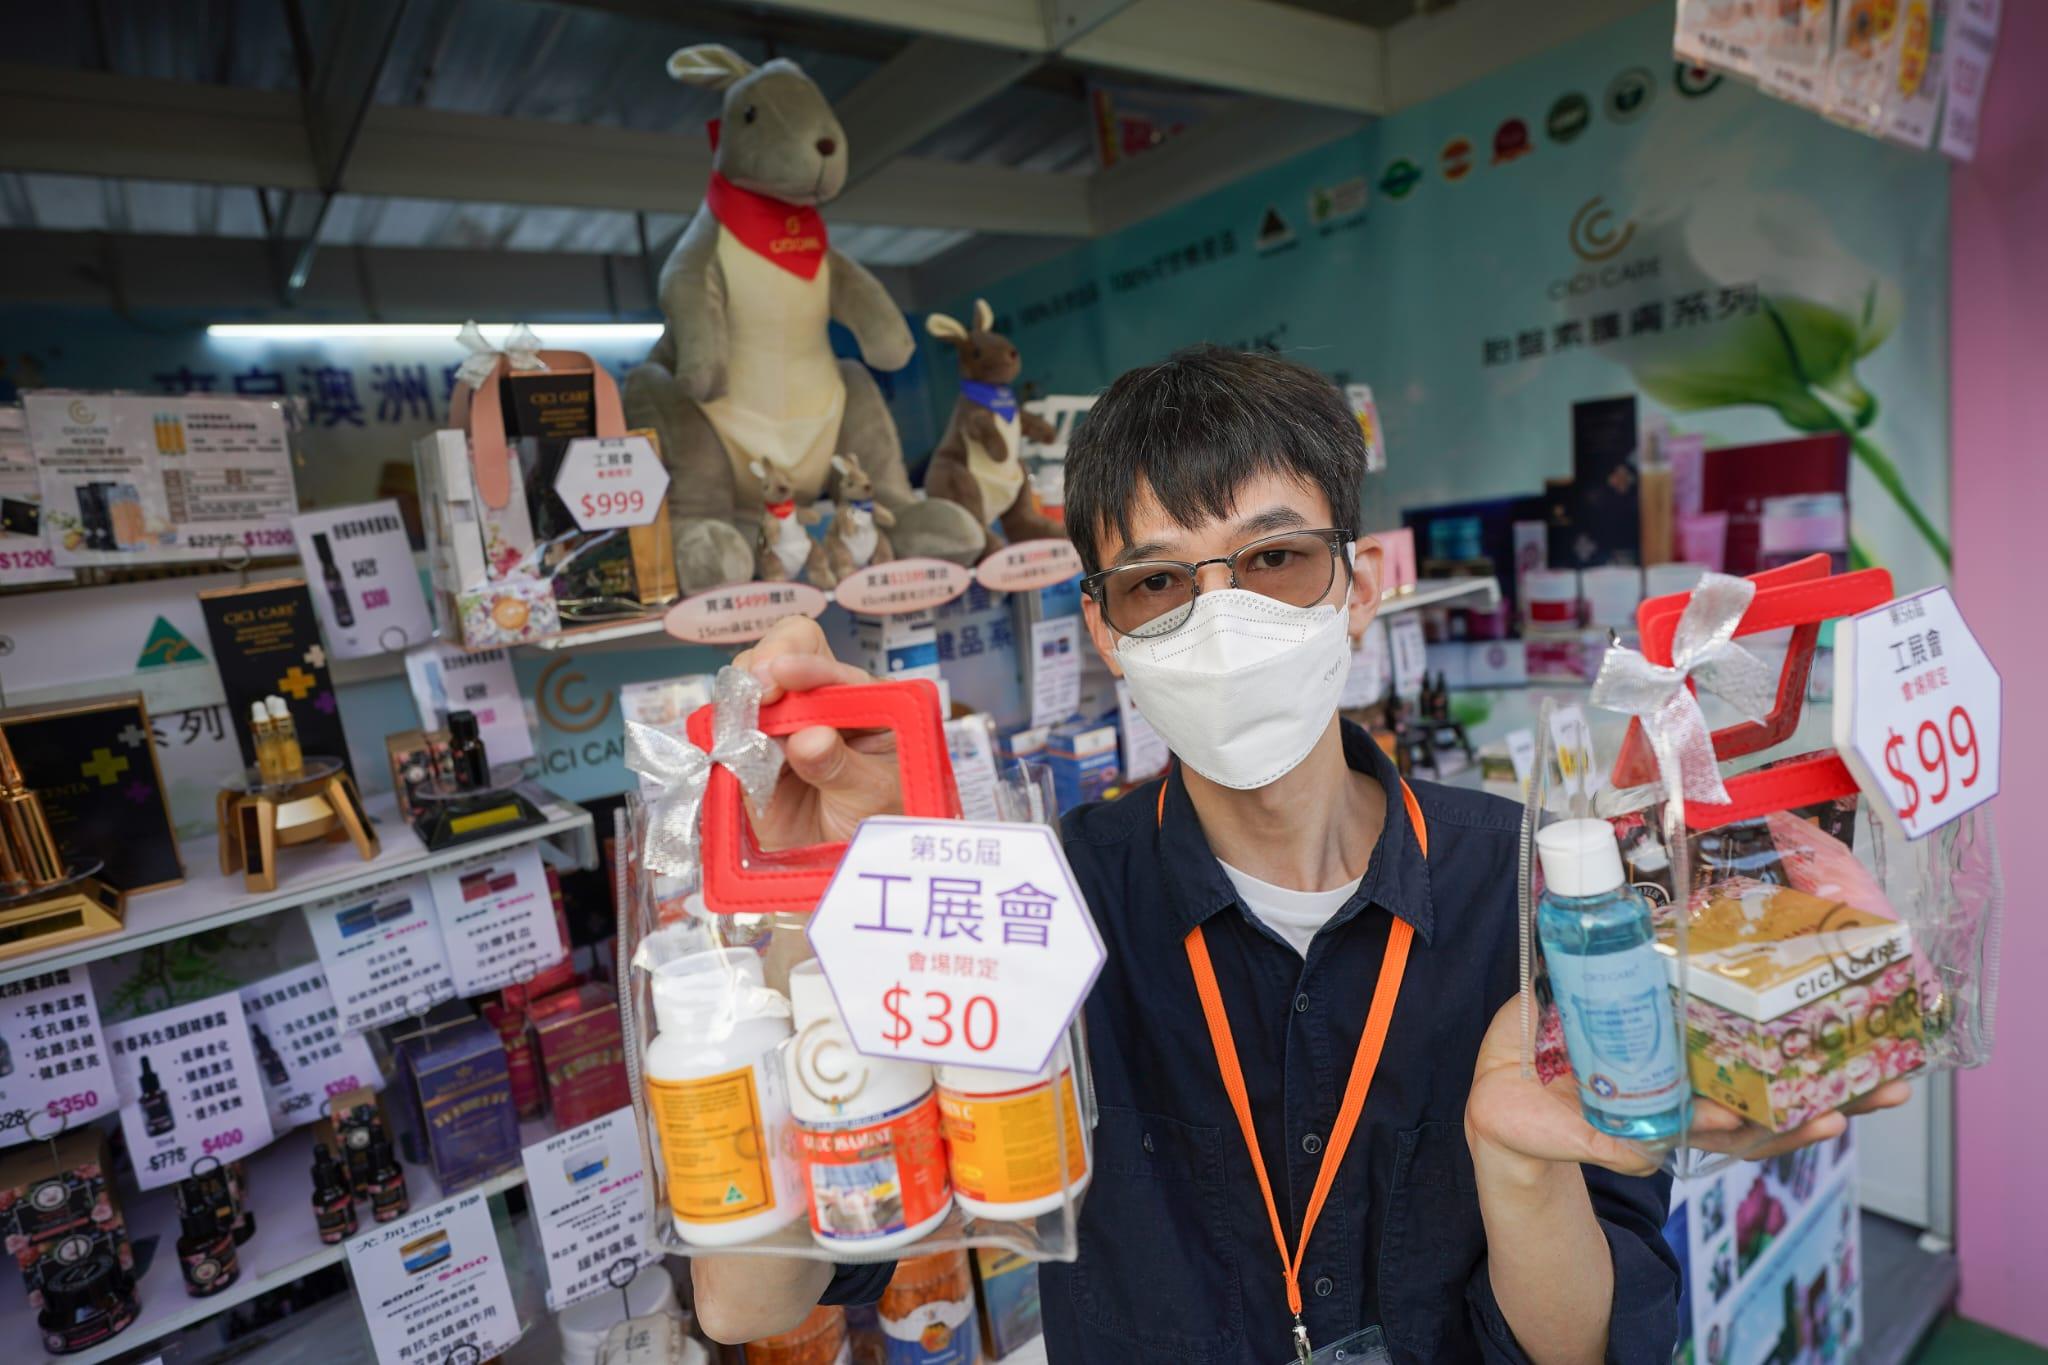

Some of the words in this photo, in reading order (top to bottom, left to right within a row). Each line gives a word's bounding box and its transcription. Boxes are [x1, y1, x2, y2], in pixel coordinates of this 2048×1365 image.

[580, 490, 645, 518] $999
[1888, 628, 1944, 674] 工展會
[1900, 665, 1951, 702] 會場限定
[582, 734, 626, 766] CA
[1884, 705, 1981, 829] $99
[911, 833, 1001, 866] 第56屆
[853, 870, 1059, 949] 工展會
[906, 950, 1001, 981] 會場限定
[1794, 969, 1842, 1000] CICI
[1849, 936, 1904, 975] CARE
[880, 981, 999, 1050] $30
[1779, 1012, 1856, 1060] CICI
[46, 1090, 99, 1119] $350
[202, 1128, 244, 1155] $400
